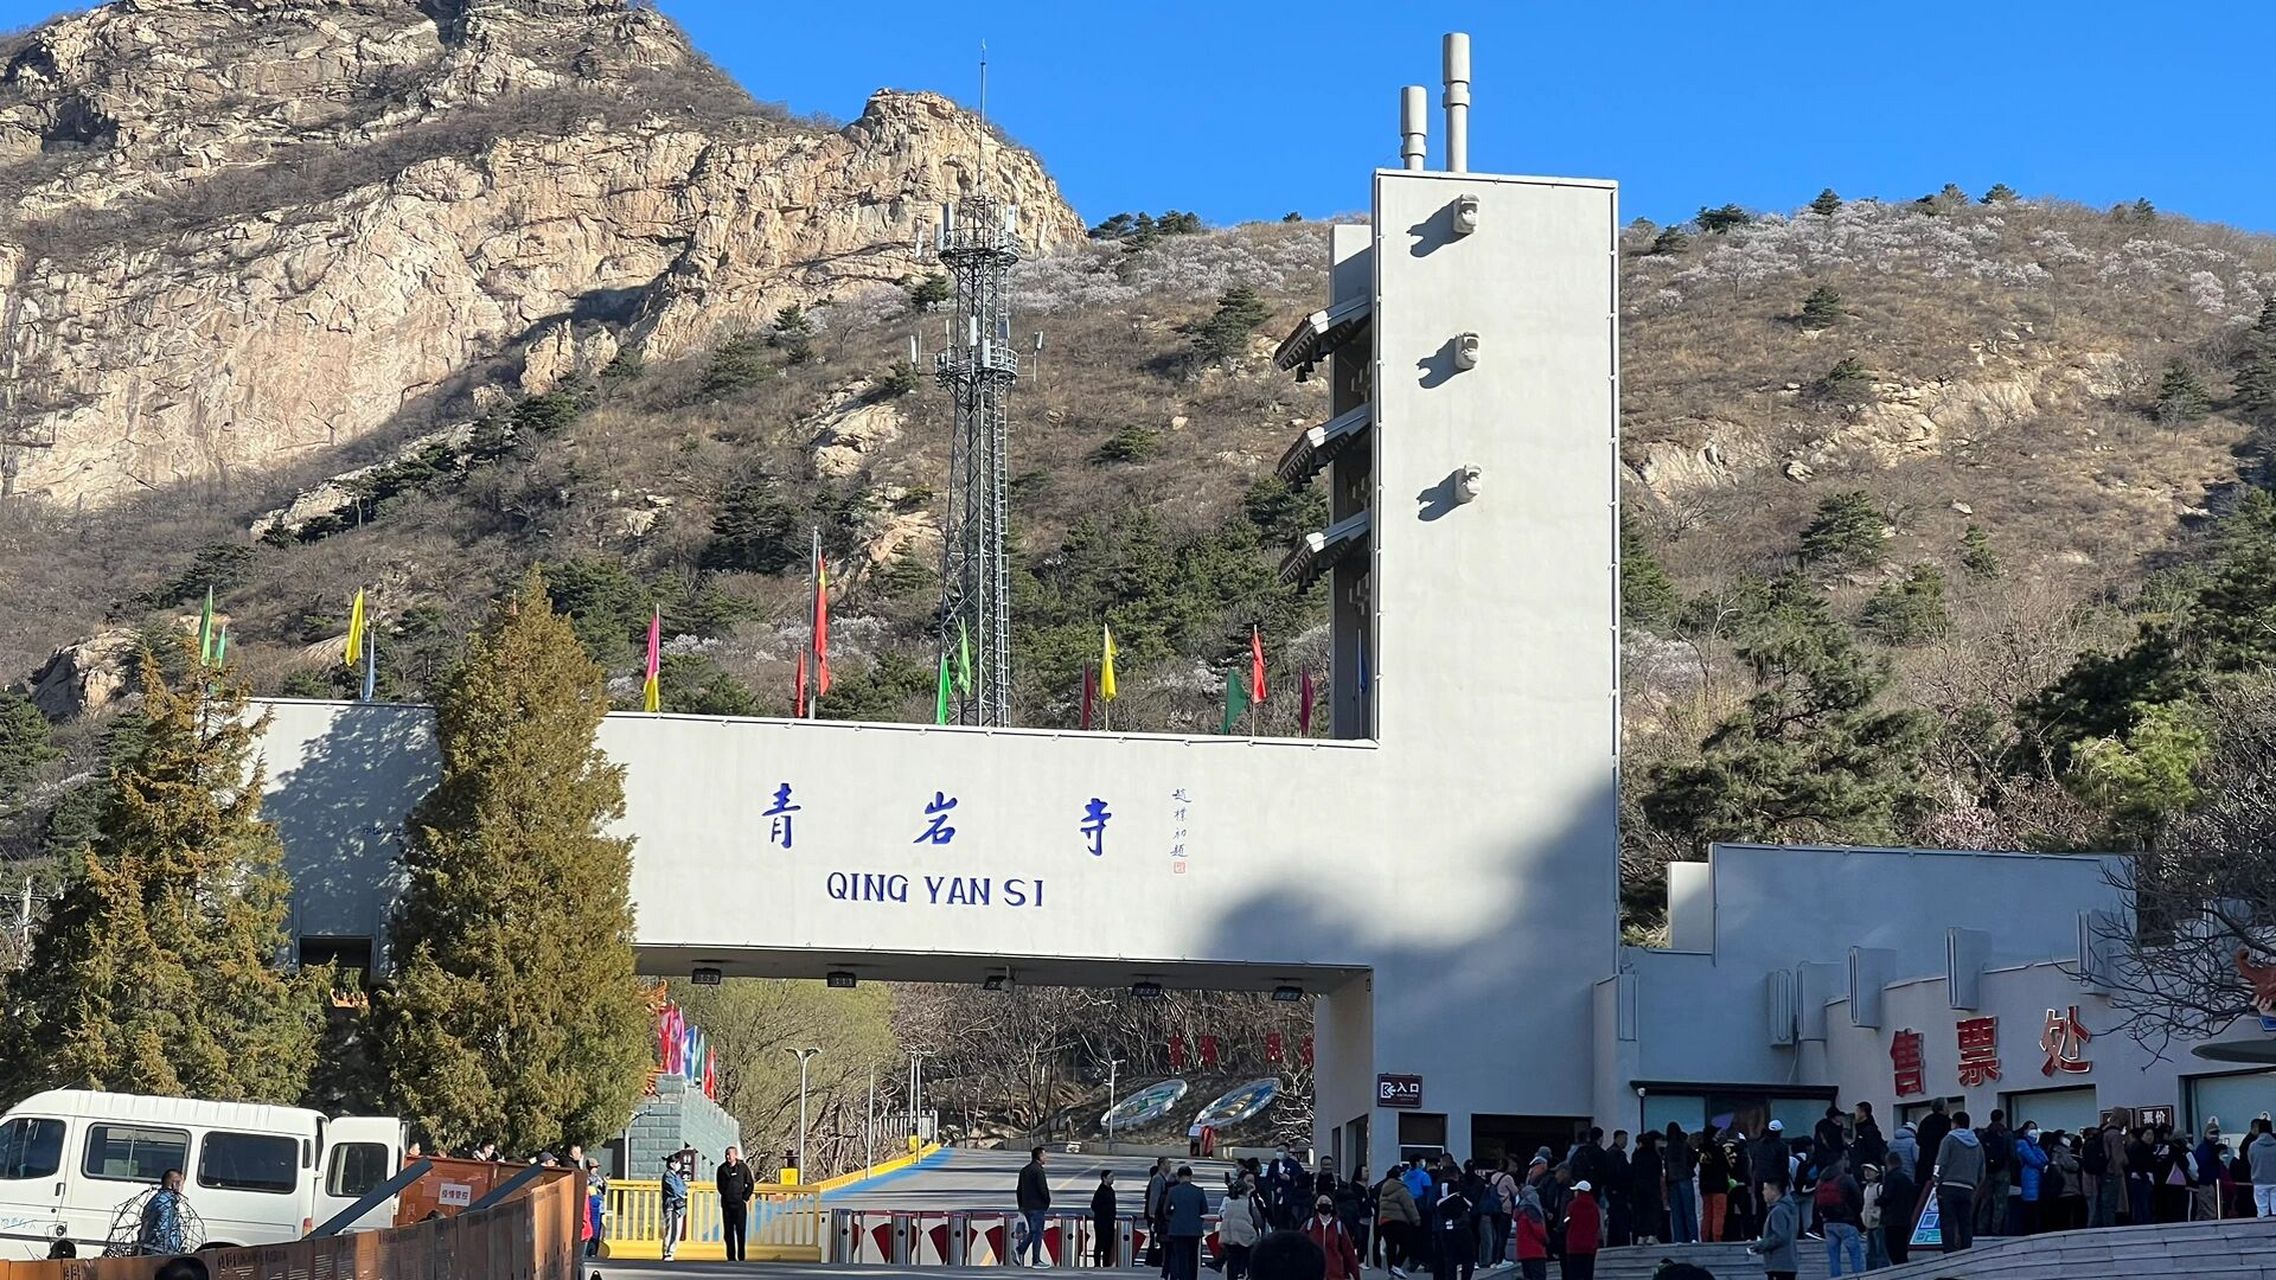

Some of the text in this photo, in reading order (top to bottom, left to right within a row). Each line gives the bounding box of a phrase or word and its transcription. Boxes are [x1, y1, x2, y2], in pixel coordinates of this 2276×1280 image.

[762, 782, 1112, 857] 青岩寺
[827, 871, 1044, 907] QING YAN SI
[1889, 1005, 2093, 1097] 售票处
[1397, 1082, 1419, 1093] 入口
[2143, 1110, 2166, 1125] 票价
